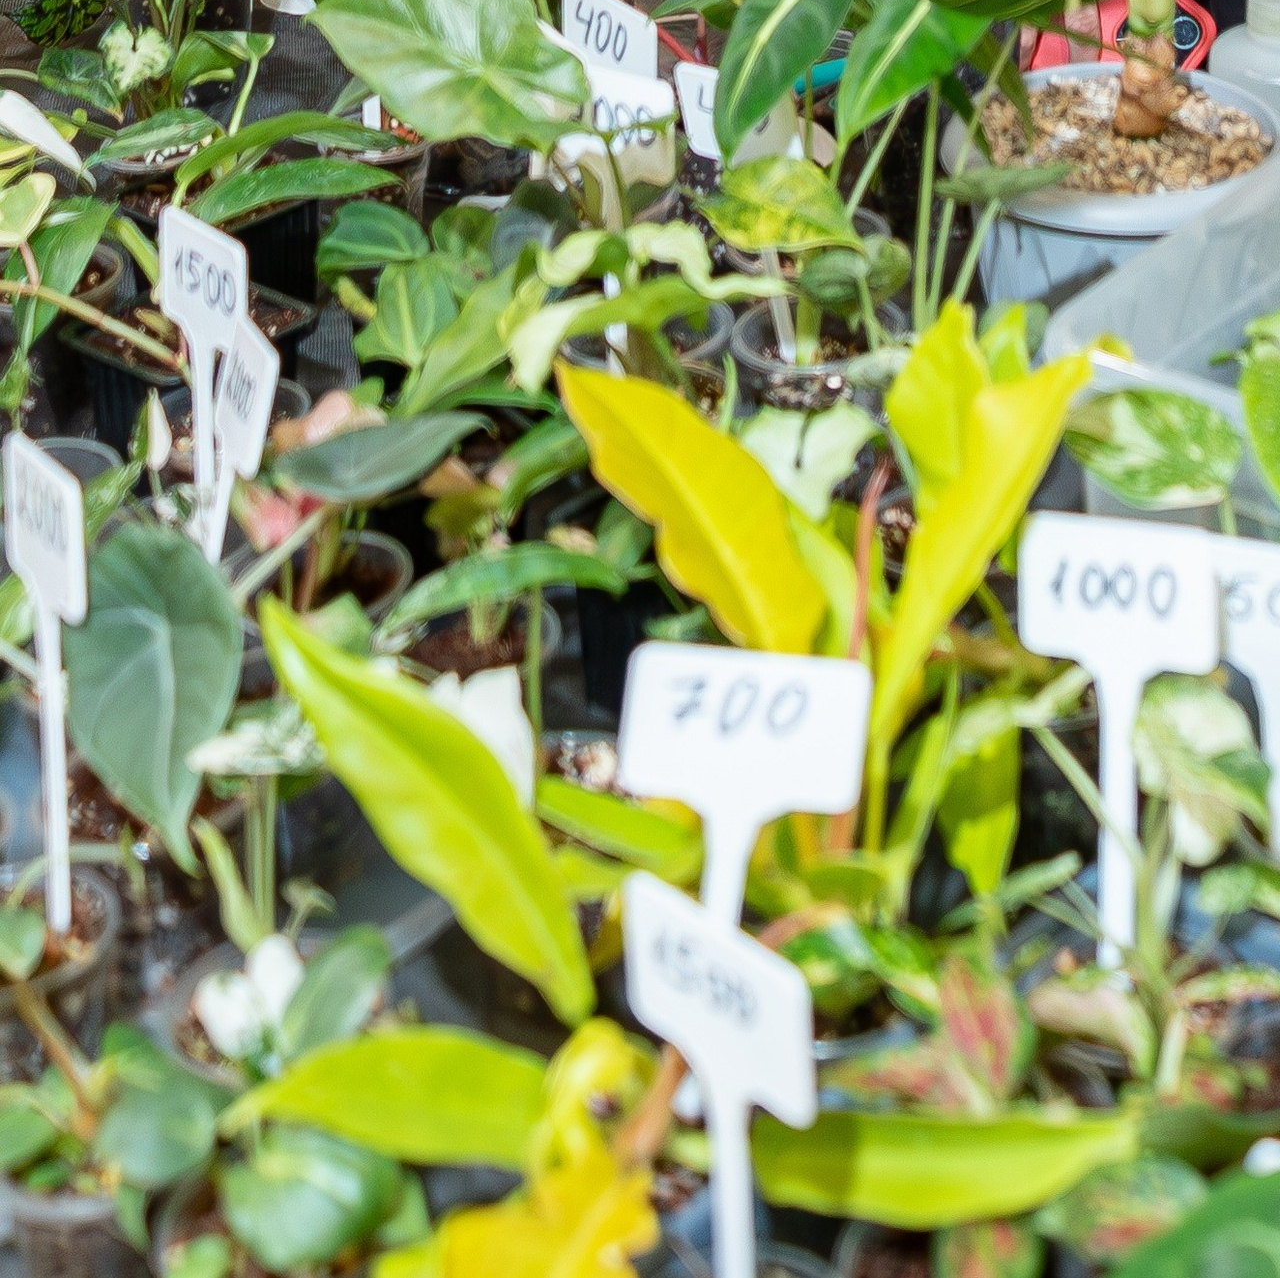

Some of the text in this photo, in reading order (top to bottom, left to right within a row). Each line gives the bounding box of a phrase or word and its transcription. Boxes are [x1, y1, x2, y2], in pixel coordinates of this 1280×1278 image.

[175, 246, 238, 317] 1500
[1050, 558, 1177, 620] 1000
[669, 664, 808, 738] 700
